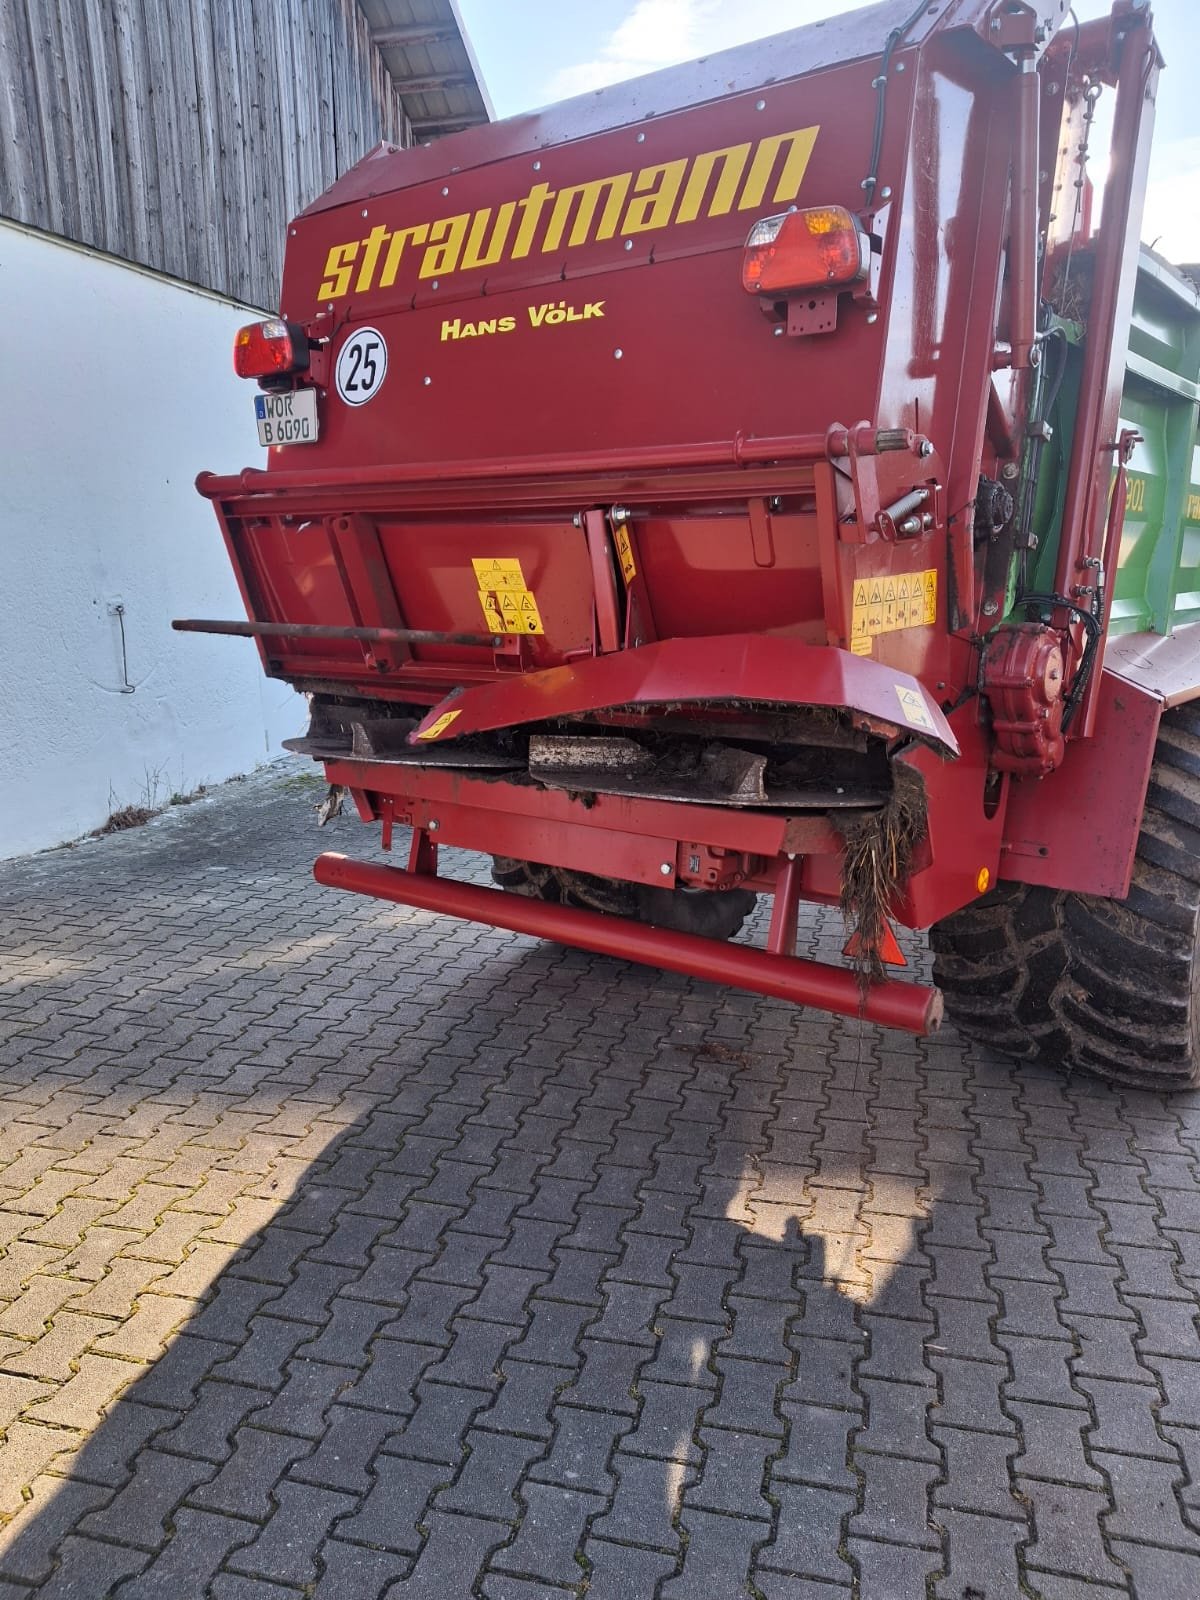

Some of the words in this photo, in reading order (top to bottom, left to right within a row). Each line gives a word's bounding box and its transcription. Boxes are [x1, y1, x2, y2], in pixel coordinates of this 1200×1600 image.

[317, 125, 820, 301] strautmann
[440, 316, 517, 342] HANS
[527, 300, 606, 328] VÖLK
[345, 342, 379, 392] 25
[265, 395, 294, 419] WOR
[264, 422, 273, 443] B
[277, 417, 310, 442] 6090
